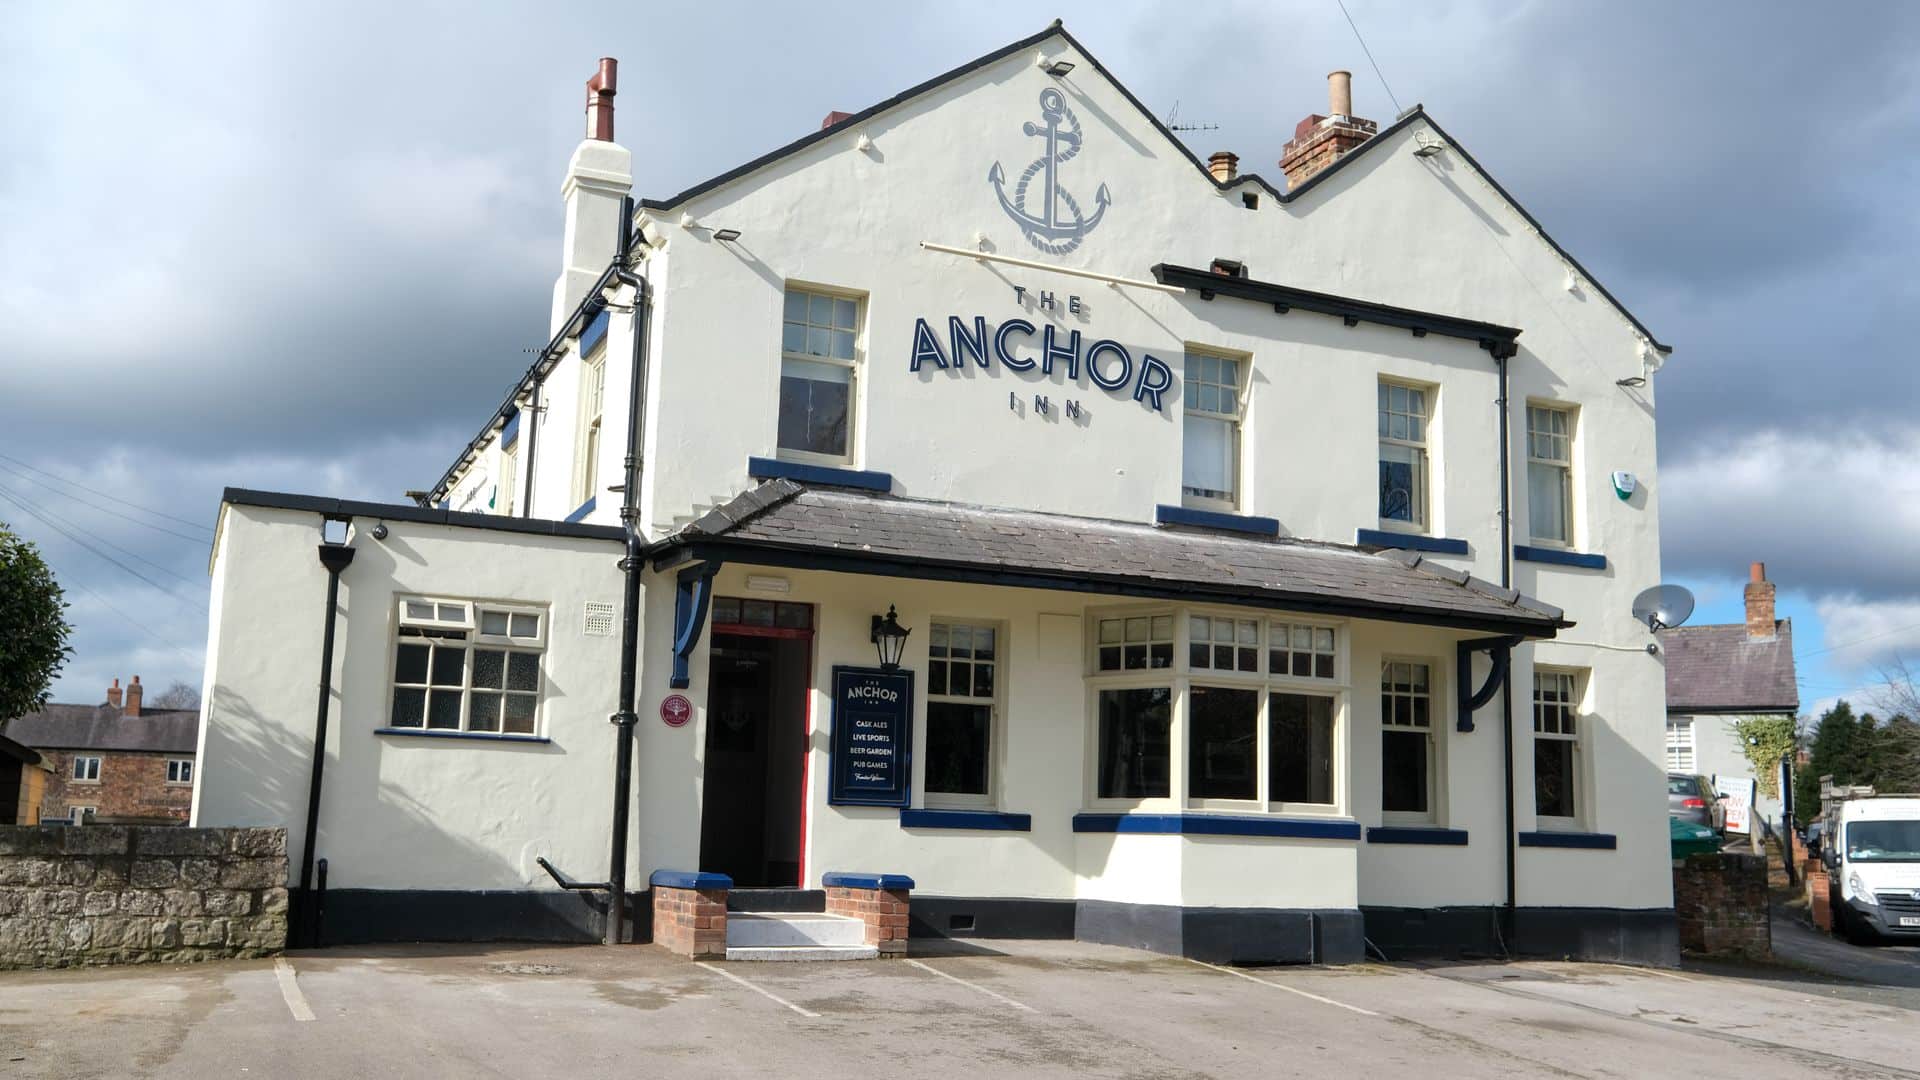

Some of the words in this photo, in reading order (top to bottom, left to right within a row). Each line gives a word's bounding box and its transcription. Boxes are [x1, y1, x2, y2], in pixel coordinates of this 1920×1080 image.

[1014, 285, 1081, 315] THE
[910, 315, 1173, 412] ANCHOR
[1009, 391, 1080, 418] INN
[847, 686, 898, 703] ANCHOR
[855, 720, 873, 728] CASK
[873, 721, 888, 729] ALES
[852, 733, 867, 741] LIVE
[867, 734, 890, 742] SPORTS
[866, 748, 892, 756] GARDEN
[853, 760, 866, 768] PUB
[866, 761, 888, 769] GAMES
